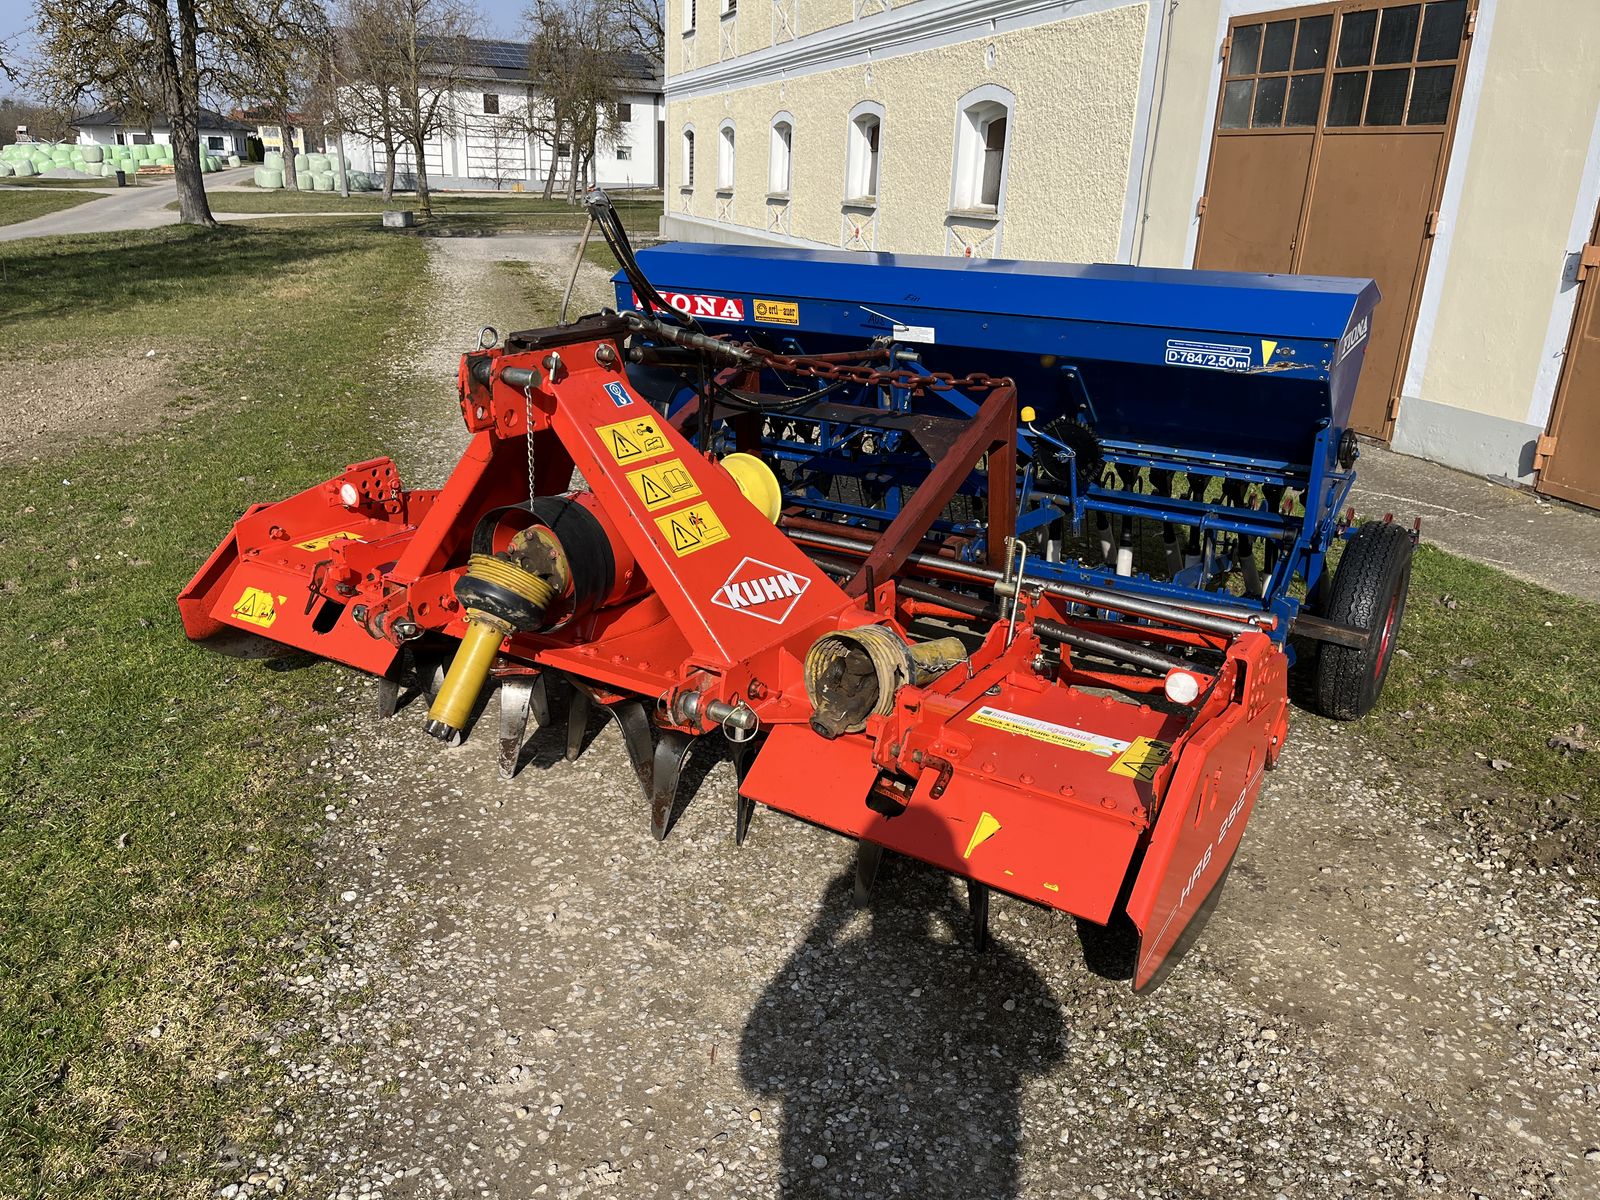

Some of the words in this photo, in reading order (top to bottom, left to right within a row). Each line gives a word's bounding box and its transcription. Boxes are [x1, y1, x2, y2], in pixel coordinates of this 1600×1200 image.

[635, 291, 742, 318] ONA
[723, 573, 801, 608] KUHN
[1217, 787, 1246, 845] 252
